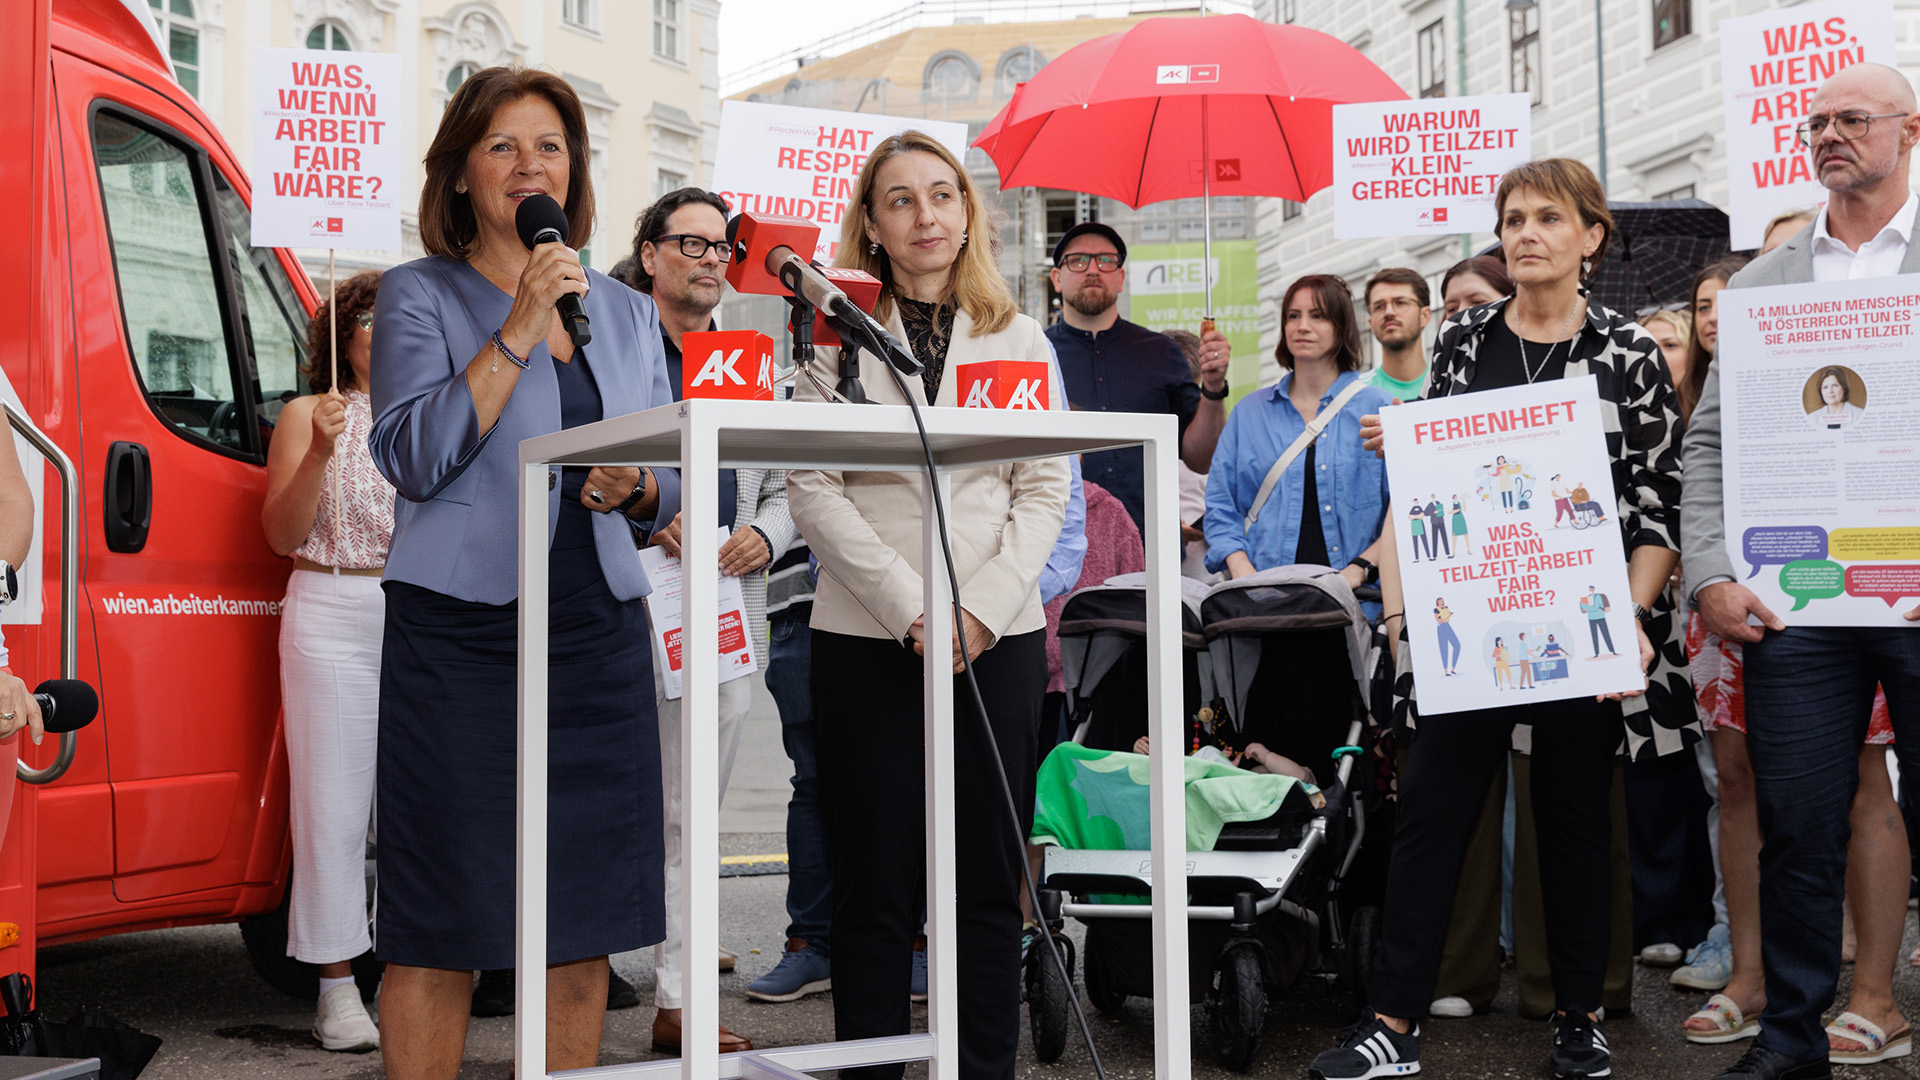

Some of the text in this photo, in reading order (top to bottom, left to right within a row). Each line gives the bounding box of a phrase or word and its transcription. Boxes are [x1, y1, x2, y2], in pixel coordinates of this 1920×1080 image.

[1763, 17, 1858, 57] WAS,
[292, 62, 371, 94] WAS,
[1750, 46, 1864, 87] WENN
[278, 89, 376, 117] WENN
[275, 118, 386, 145] ARBEIT
[768, 124, 818, 136] #RedenWir
[1383, 109, 1480, 133] WARUM
[817, 126, 874, 152] HAT
[1347, 128, 1519, 157] WIRD TEILZEIT
[294, 145, 361, 171] FAIR
[1391, 154, 1473, 177] KLEIN-
[273, 167, 382, 199] WÄRE?
[1352, 174, 1505, 201] GERECHNET
[821, 268, 870, 280] ORF
[1146, 308, 1179, 321] WIR
[1758, 320, 1772, 332] IN
[1775, 314, 1859, 331] ÖSTERREICH
[1862, 311, 1890, 324] TUN
[1894, 310, 1911, 321] ES
[1769, 301, 1842, 318] MILLIONEN
[1764, 323, 1914, 346] SIE ARBEITEN TEILZEIT.
[1793, 346, 1816, 355] haben
[1827, 344, 1848, 352] einen
[1879, 341, 1904, 349] Grund.
[690, 349, 747, 387] AK
[756, 352, 773, 391] AK
[963, 378, 996, 409] AK
[1005, 378, 1045, 411] AK
[1414, 400, 1577, 445] FERIENHEFT
[1436, 441, 1472, 452] Aufgaben
[1473, 439, 1483, 447] für
[1497, 428, 1561, 444] Bundesregierung
[1488, 521, 1539, 542] WAS,
[1482, 538, 1544, 561] WENN
[1439, 548, 1594, 584] TEILZEIT-ARBEIT
[1497, 574, 1541, 594] FAIR
[1488, 589, 1556, 613] WÄRE?
